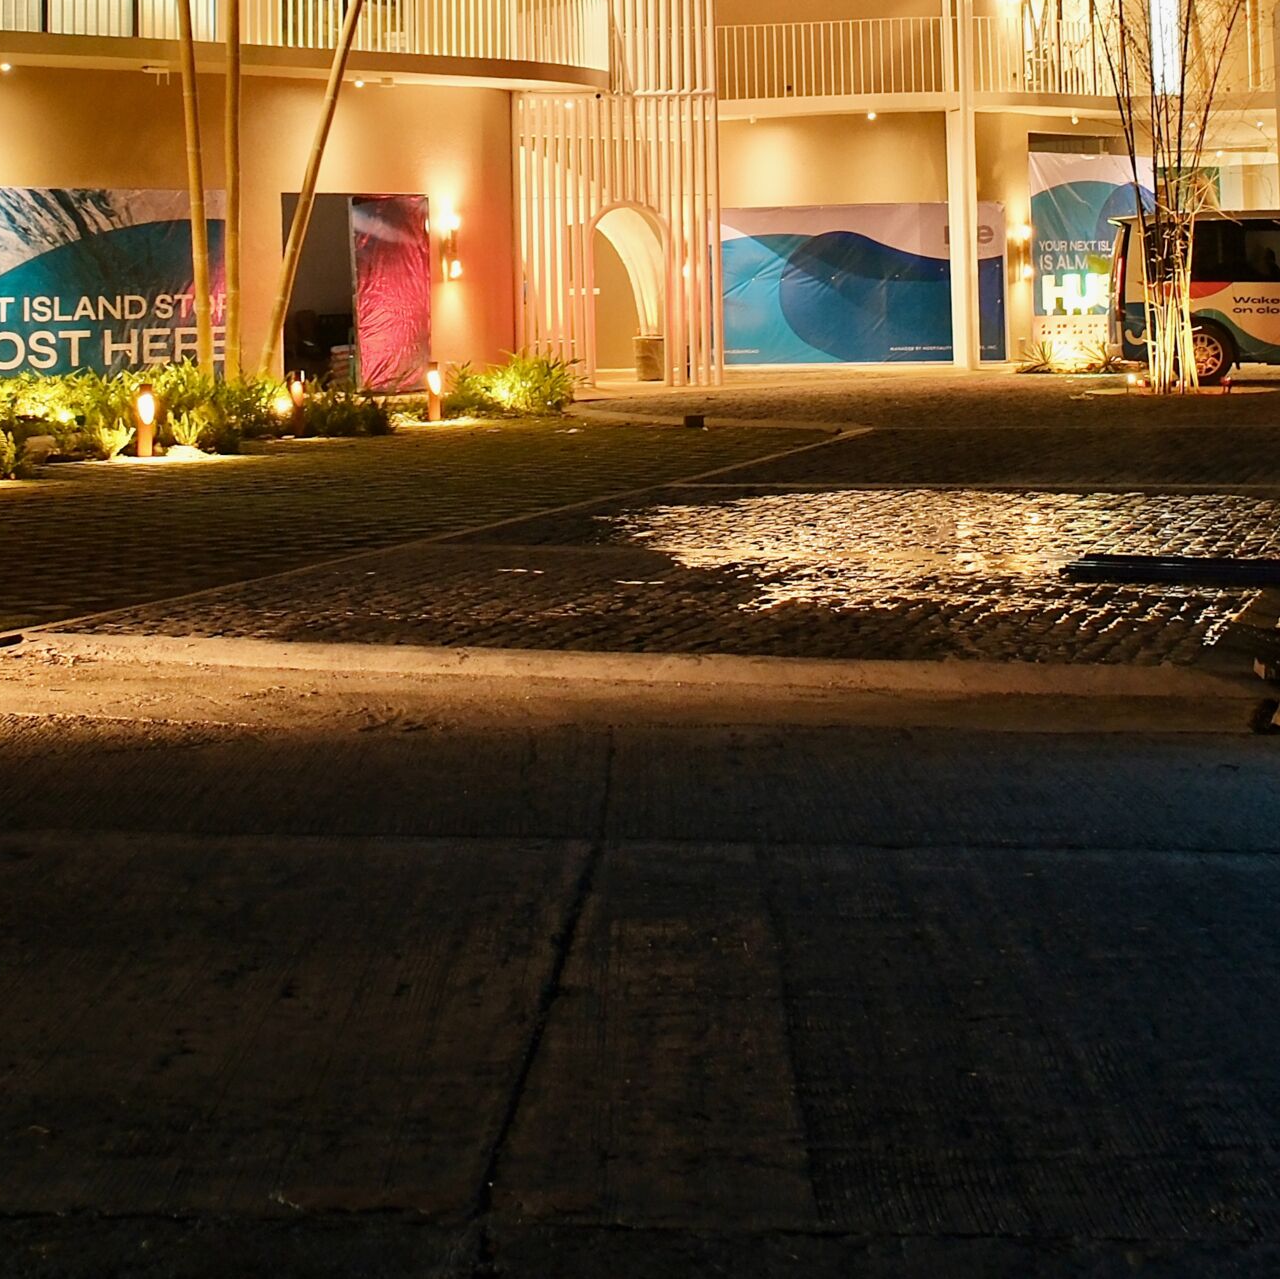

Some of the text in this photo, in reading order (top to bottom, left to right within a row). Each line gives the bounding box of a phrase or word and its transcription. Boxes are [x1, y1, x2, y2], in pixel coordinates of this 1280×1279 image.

[1039, 240, 1112, 252] YOUR NEXT ISL
[1040, 254, 1053, 271] IS
[1233, 296, 1280, 304] Wake
[23, 294, 148, 322] ISLAND
[1232, 306, 1253, 314] on
[103, 326, 227, 367] HERE
